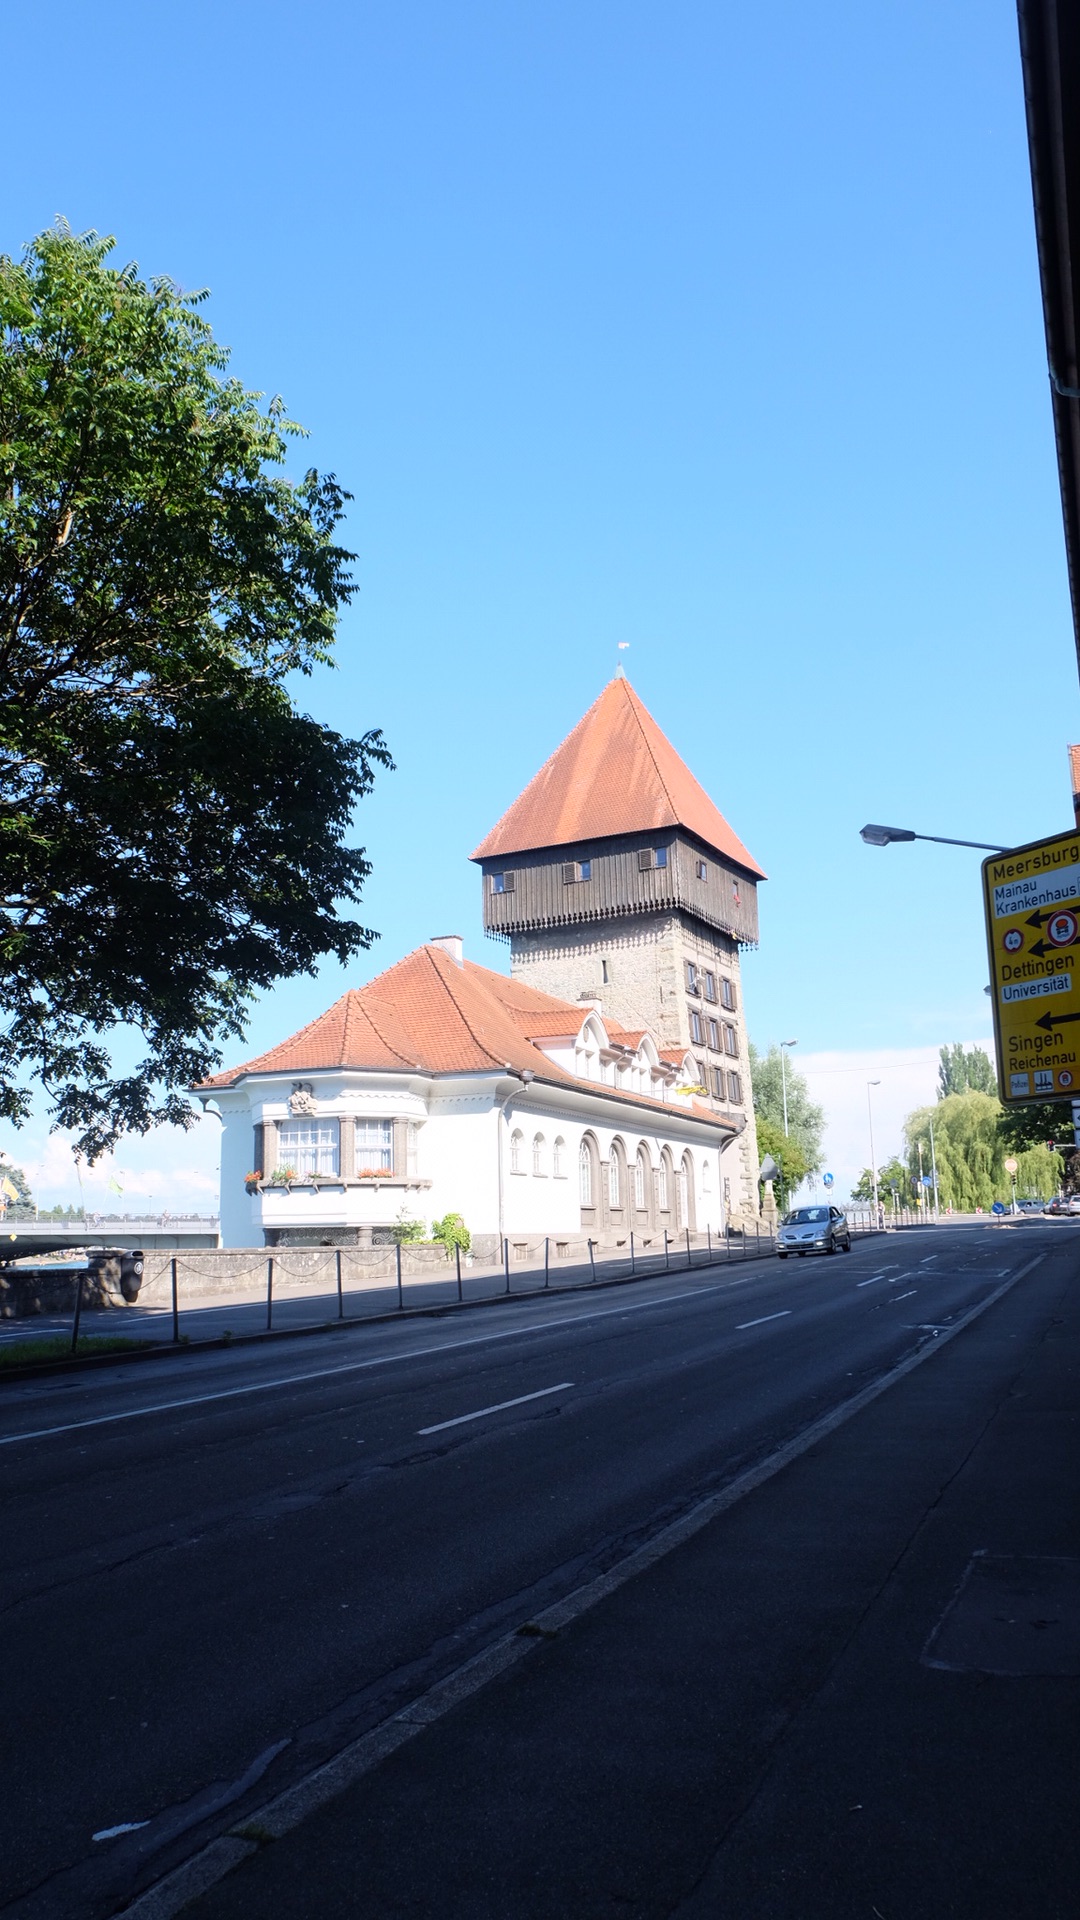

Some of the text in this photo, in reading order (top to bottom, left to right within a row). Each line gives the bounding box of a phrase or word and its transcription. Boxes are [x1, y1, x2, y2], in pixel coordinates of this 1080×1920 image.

[993, 845, 1079, 881] Meersburg
[995, 881, 1037, 901] Mainau
[996, 885, 1077, 916] Krankenhaus
[1002, 955, 1075, 981] Dettingen
[1003, 976, 1069, 1000] Universität
[1008, 1032, 1064, 1053] Singen
[1009, 1052, 1076, 1071] Reichenau
